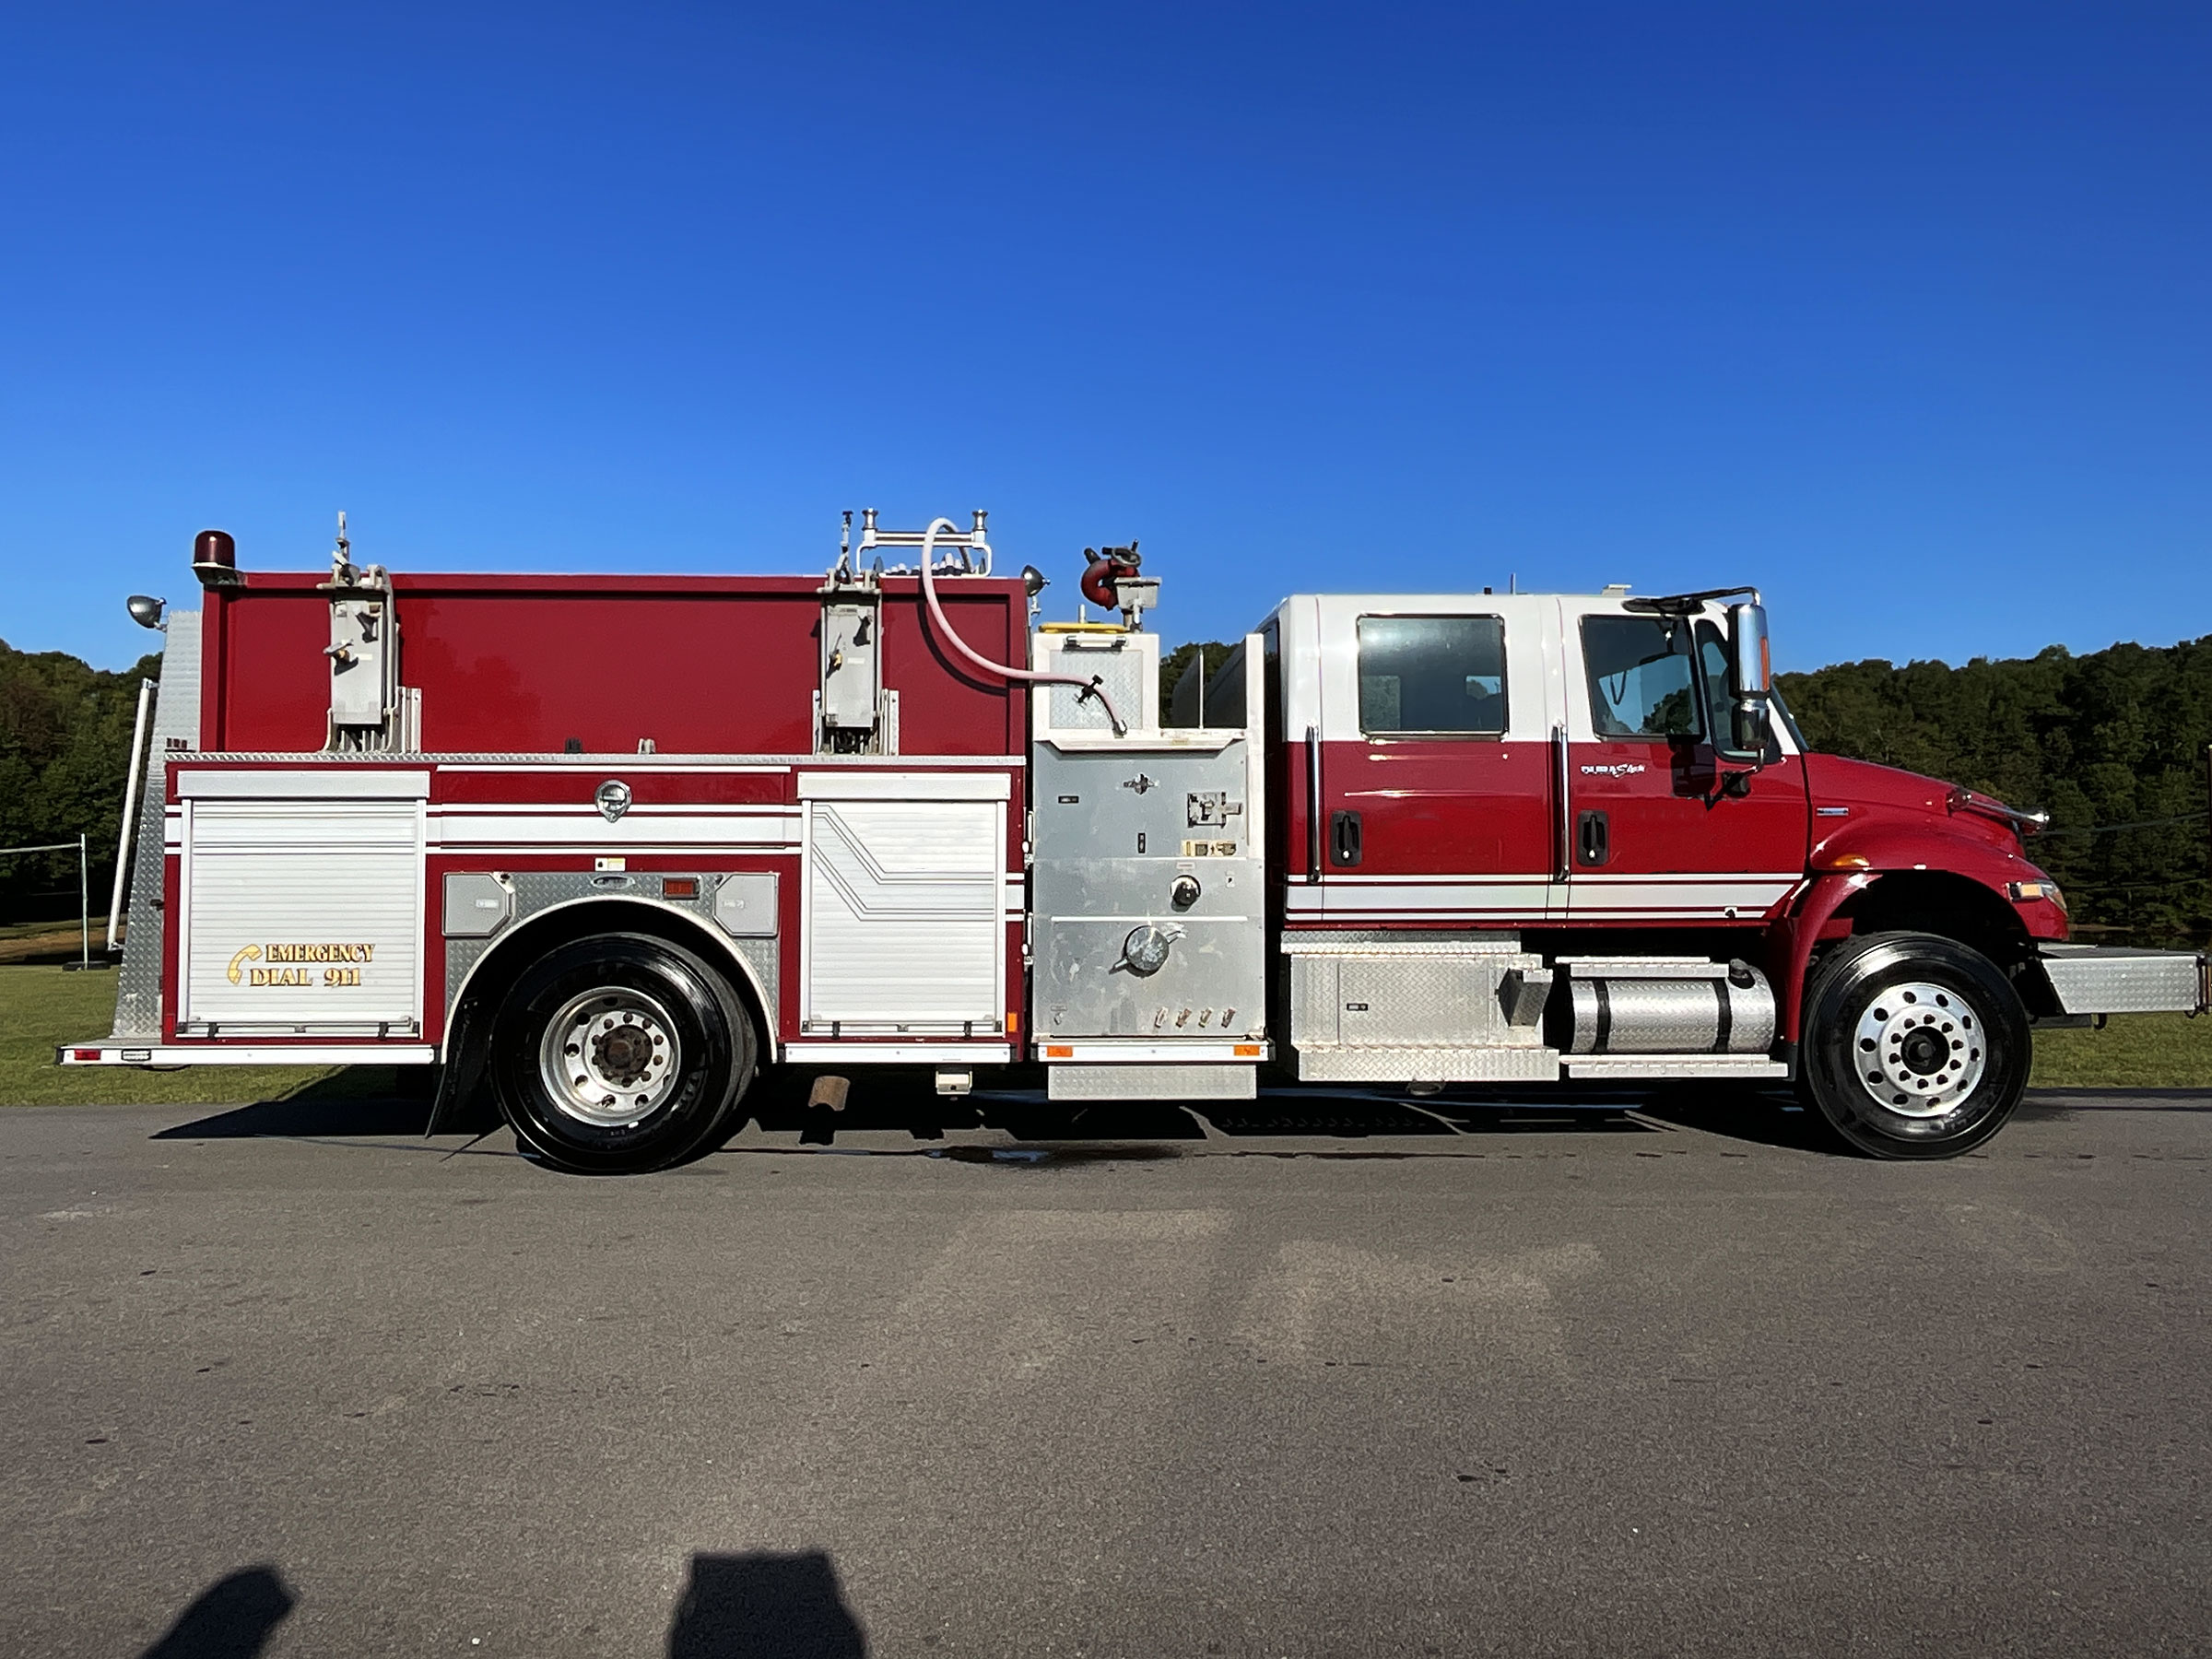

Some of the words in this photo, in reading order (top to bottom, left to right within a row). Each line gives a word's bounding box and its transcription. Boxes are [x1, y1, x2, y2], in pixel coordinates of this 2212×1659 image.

[265, 943, 375, 963] EMERGENCY
[250, 968, 313, 987] DIAL
[324, 967, 361, 987] 911
